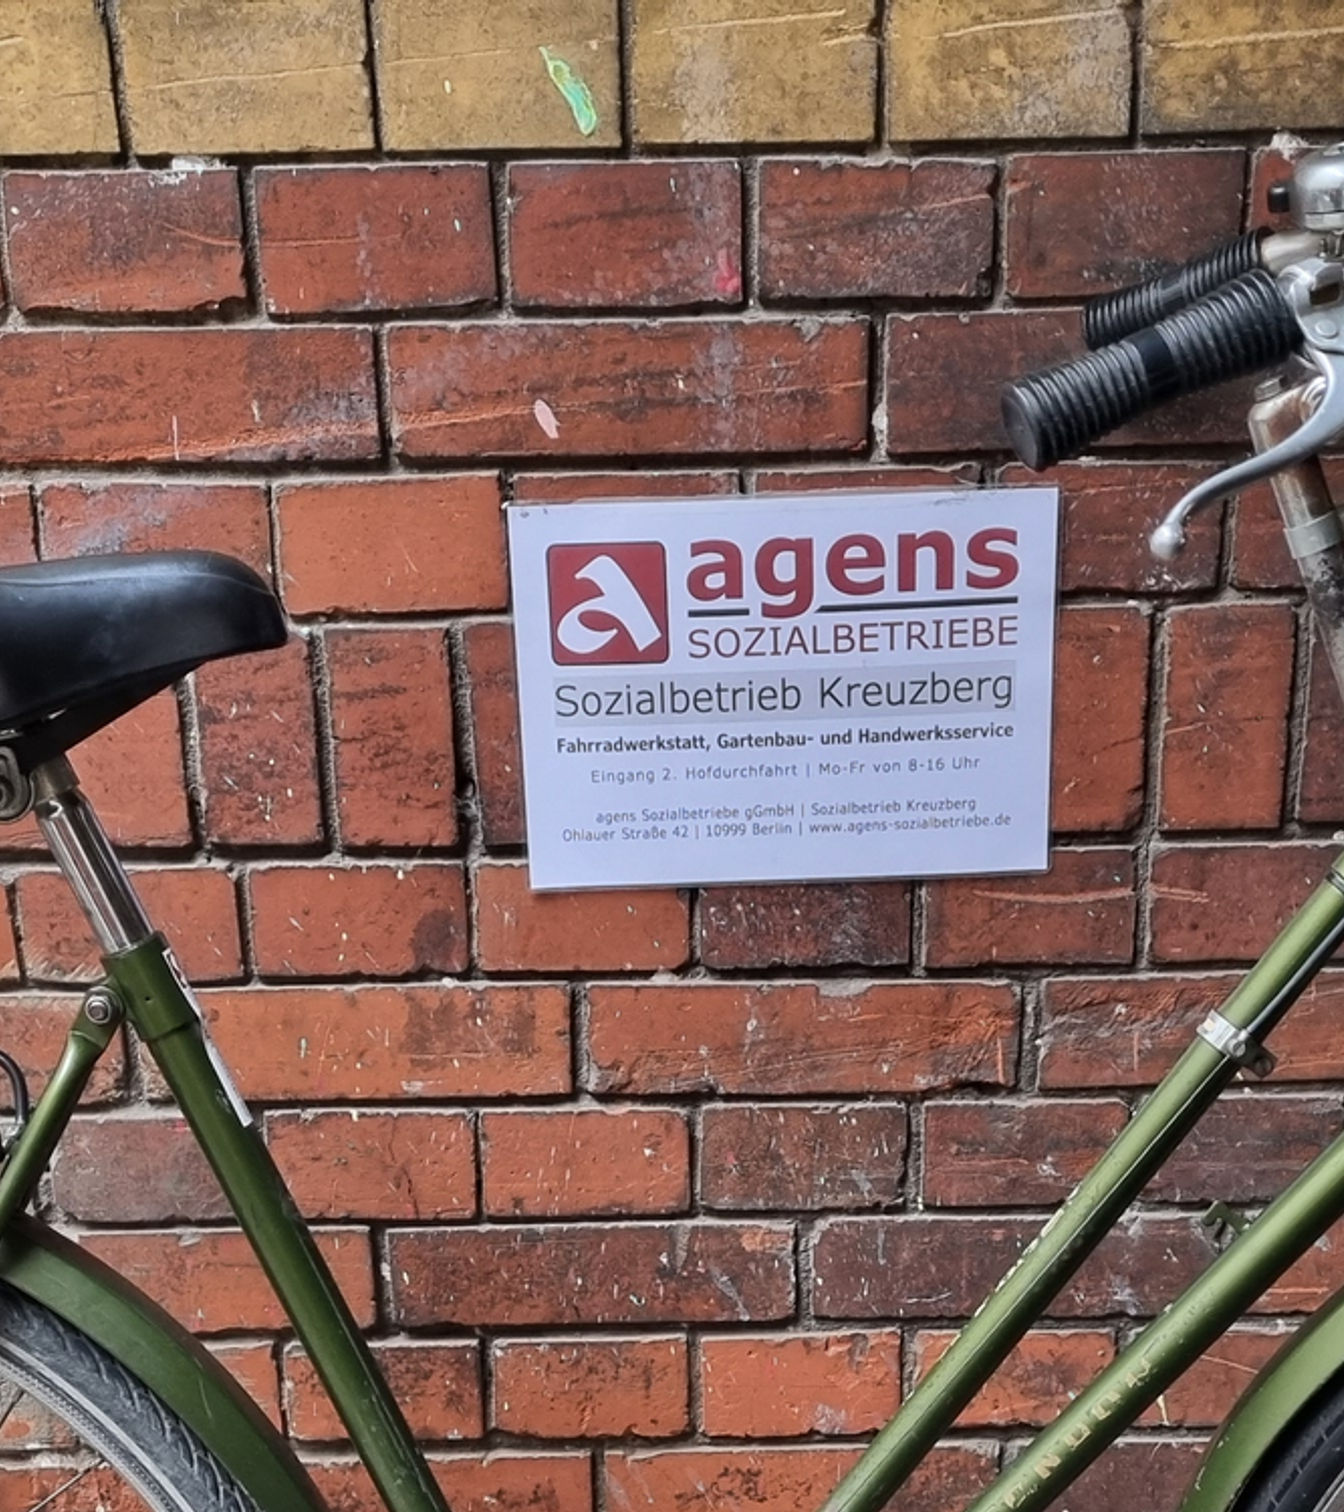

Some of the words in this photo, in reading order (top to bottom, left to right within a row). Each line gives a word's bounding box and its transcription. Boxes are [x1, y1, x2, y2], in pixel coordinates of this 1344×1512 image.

[686, 527, 1019, 619] agens
[688, 615, 1018, 659] SOZIALBETRIEBE
[555, 677, 802, 717] Sozialbetrieb
[819, 671, 1013, 709] Kreuzberg
[556, 734, 711, 753] Fahrradwerkstatt,
[717, 731, 814, 749] Gartenbau-
[820, 728, 853, 745] und
[858, 722, 1014, 744] Handwerksservice
[591, 769, 655, 785] Eingang
[662, 767, 677, 781] 2.
[685, 764, 798, 780] Hofdurchfahrt
[819, 760, 865, 775] Mo-Fr
[873, 760, 901, 773] von
[908, 757, 945, 771] 8-16
[951, 755, 981, 769] Uhr
[595, 810, 637, 825] agens
[641, 806, 739, 822] Sozialbetriebe
[744, 803, 795, 820] gGmbH
[810, 799, 901, 816] Sozialbetrieb
[906, 797, 977, 814] Kreuzberg
[562, 828, 616, 842] Ohlauer
[621, 825, 667, 840] Straße
[672, 825, 689, 839] 42
[706, 823, 747, 838] 10999
[752, 821, 793, 836] Berlin
[809, 813, 1012, 836] www.agens-sozialbetriebe.de
